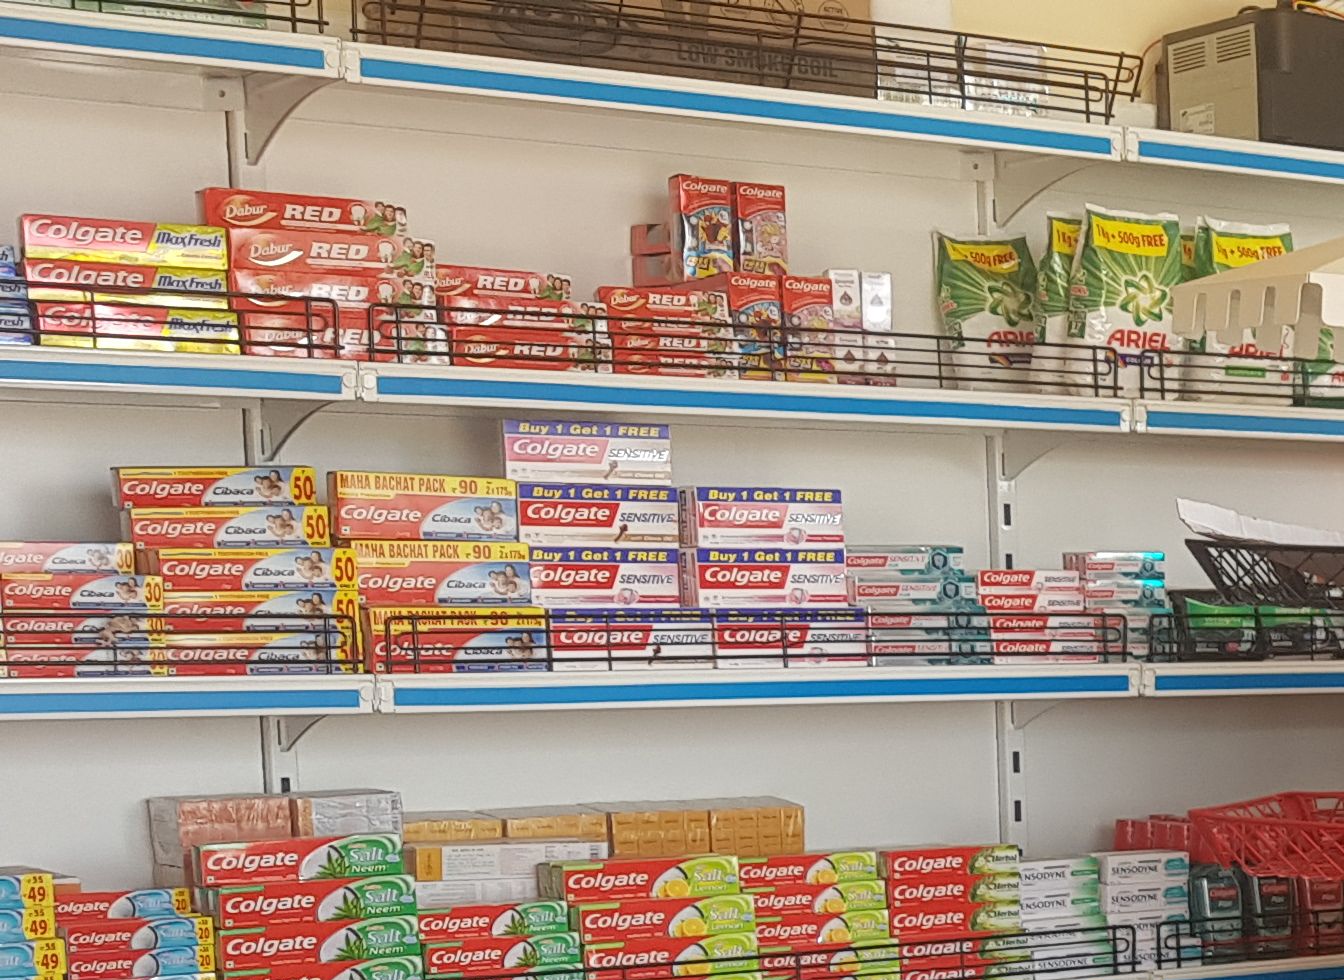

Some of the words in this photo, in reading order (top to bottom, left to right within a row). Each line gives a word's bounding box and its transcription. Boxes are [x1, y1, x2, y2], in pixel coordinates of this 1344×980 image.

[225, 201, 269, 220] Dabur
[283, 204, 342, 221] RED
[29, 218, 143, 247] Colgate
[155, 231, 222, 249] MaxFresh
[249, 241, 294, 259] Dabur
[310, 242, 369, 261] RED
[992, 251, 1015, 267] FREE
[28, 261, 144, 290] Colgate
[157, 272, 223, 291] MaxFresh
[477, 275, 524, 291] RED
[1107, 328, 1171, 352] ARIEL
[519, 424, 548, 439] Buy
[556, 424, 562, 437] 1
[570, 424, 598, 437] Get
[604, 424, 610, 437] 1
[616, 424, 660, 438] FREE
[122, 480, 204, 499] Colgate
[213, 486, 254, 498] Cibaca
[292, 475, 314, 500] 50
[340, 476, 372, 491] MAHA
[375, 476, 415, 492] BACHAT
[418, 477, 446, 493] PACK
[532, 487, 561, 502] Buy
[569, 487, 576, 500] 1
[581, 487, 610, 500] Get
[615, 487, 621, 500] 1
[627, 487, 669, 501] FREE
[340, 504, 421, 525] Colgate
[432, 513, 472, 526] Cibaca
[527, 503, 610, 525] Colgate
[619, 512, 674, 525] SENSITIVE
[703, 506, 781, 527] Colgate
[788, 513, 841, 527] SENSITIVE
[134, 519, 216, 538] Colgate
[225, 524, 267, 536] Cibaca
[305, 514, 327, 540] 50
[162, 560, 244, 579] Colgate
[254, 567, 295, 578] Cibaca
[334, 557, 356, 583] 50
[531, 566, 609, 588] Colgate
[619, 573, 674, 586] SENSITIVE
[704, 566, 782, 588] Colgate
[790, 574, 843, 586] SENSITIVE
[358, 573, 436, 592] Colgate
[446, 579, 487, 591] Cibaca
[206, 852, 298, 874] Colgate
[350, 846, 383, 864] Salt
[351, 864, 388, 873] Neem
[1111, 863, 1158, 877] SENSODYNE
[567, 870, 649, 891] Colgate
[692, 868, 722, 883] Salt
[28, 885, 47, 903] 49
[225, 893, 315, 916] Colgate
[365, 888, 398, 905] Salt
[367, 905, 400, 915] Neem
[585, 911, 665, 930] Colgate
[708, 907, 740, 921] Salt
[894, 909, 964, 929] Colgate
[226, 933, 317, 956] Colgate
[365, 928, 401, 945] Salt
[369, 946, 403, 956] Neem
